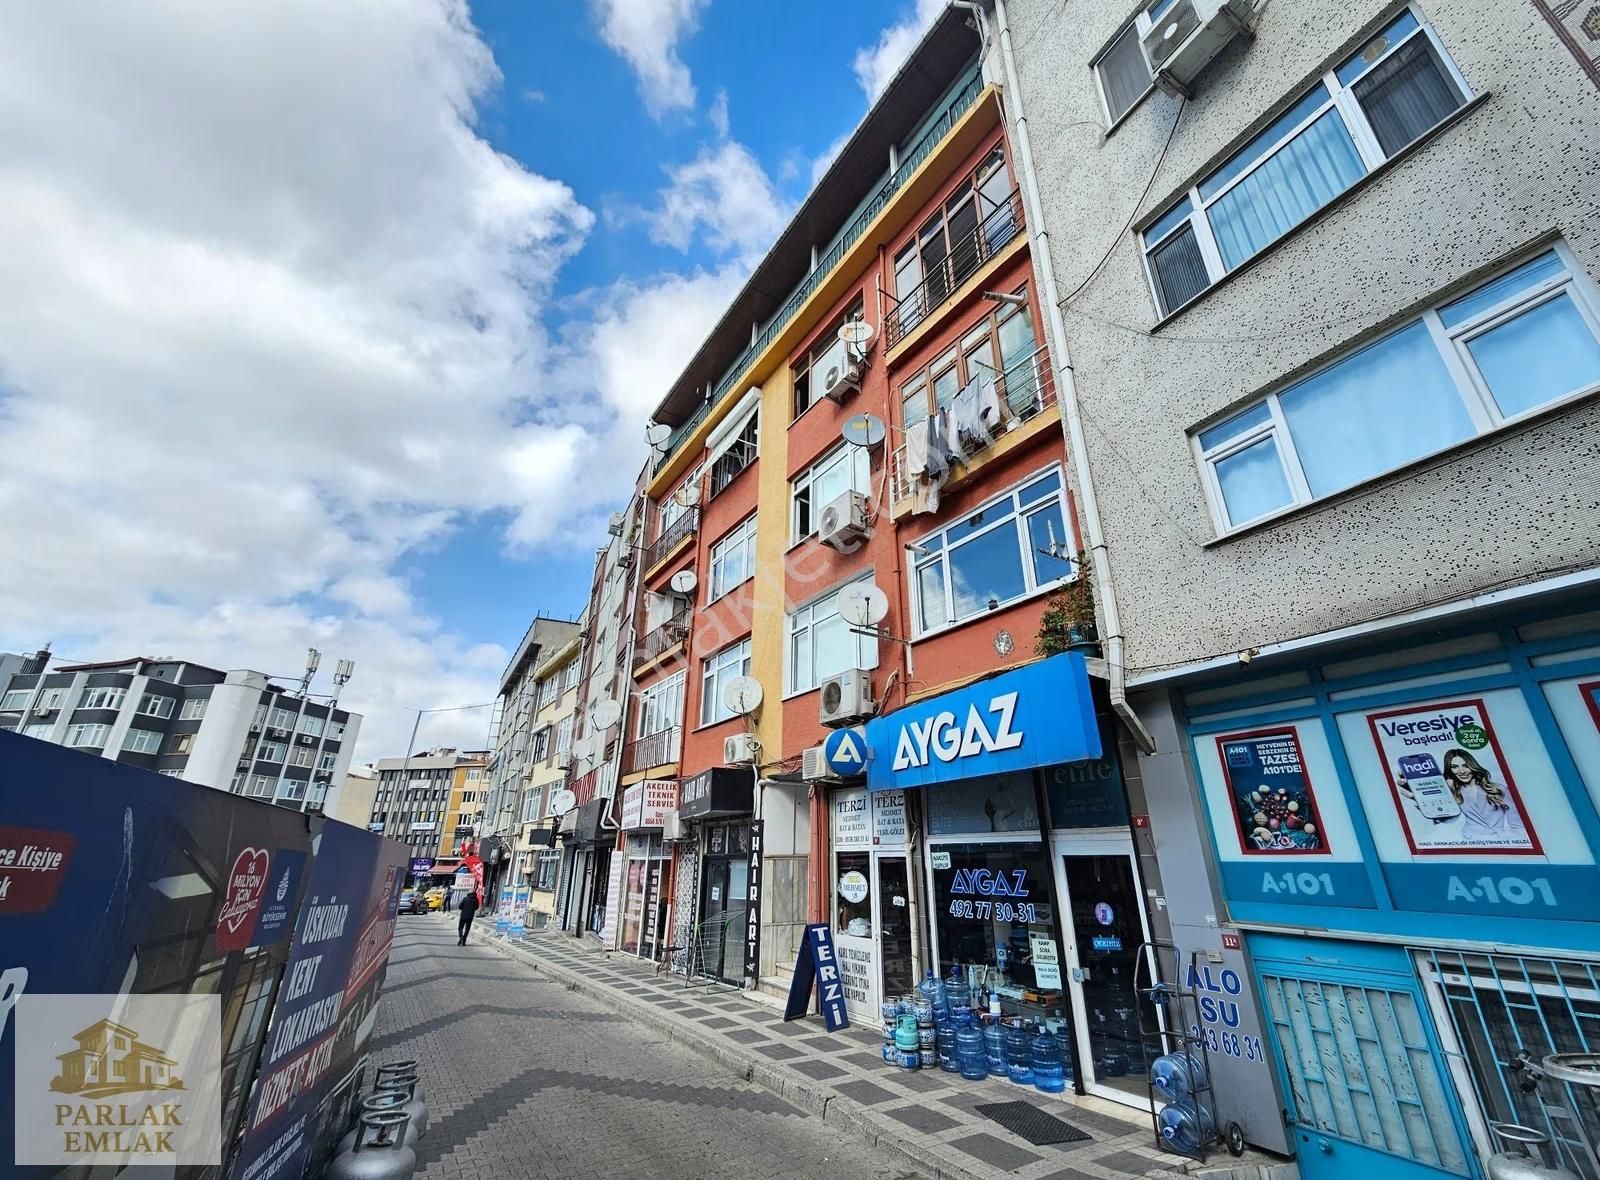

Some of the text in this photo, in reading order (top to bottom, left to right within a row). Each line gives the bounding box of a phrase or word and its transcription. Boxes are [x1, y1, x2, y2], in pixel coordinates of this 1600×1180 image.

[892, 691, 1023, 771] AYGAZ
[1381, 714, 1475, 737] Veresiye
[1403, 732, 1454, 747] başladı!
[1259, 753, 1300, 765] TAZESİ
[1264, 765, 1303, 775] A101'DE!
[1404, 759, 1435, 770] hadi
[648, 791, 674, 799] TEKNİK
[838, 795, 866, 813] TERZİ
[17, 845, 63, 872] Kişiye
[248, 862, 256, 874] 16
[843, 883, 866, 892] MEHMET
[950, 868, 1029, 897] AYGAZ
[748, 836, 760, 958] HAIR ART
[302, 895, 349, 945] ÜSKÜDAR
[950, 899, 1036, 924] 492 77 30-31
[285, 954, 323, 1003] KENT
[812, 926, 842, 1026] TERZİ
[1186, 963, 1242, 995] ALO
[1200, 996, 1241, 1028] SU
[1221, 1031, 1241, 1058] 68
[1243, 1034, 1265, 1064] 31
[252, 1032, 337, 1130] HİZMETE AÇTIK
